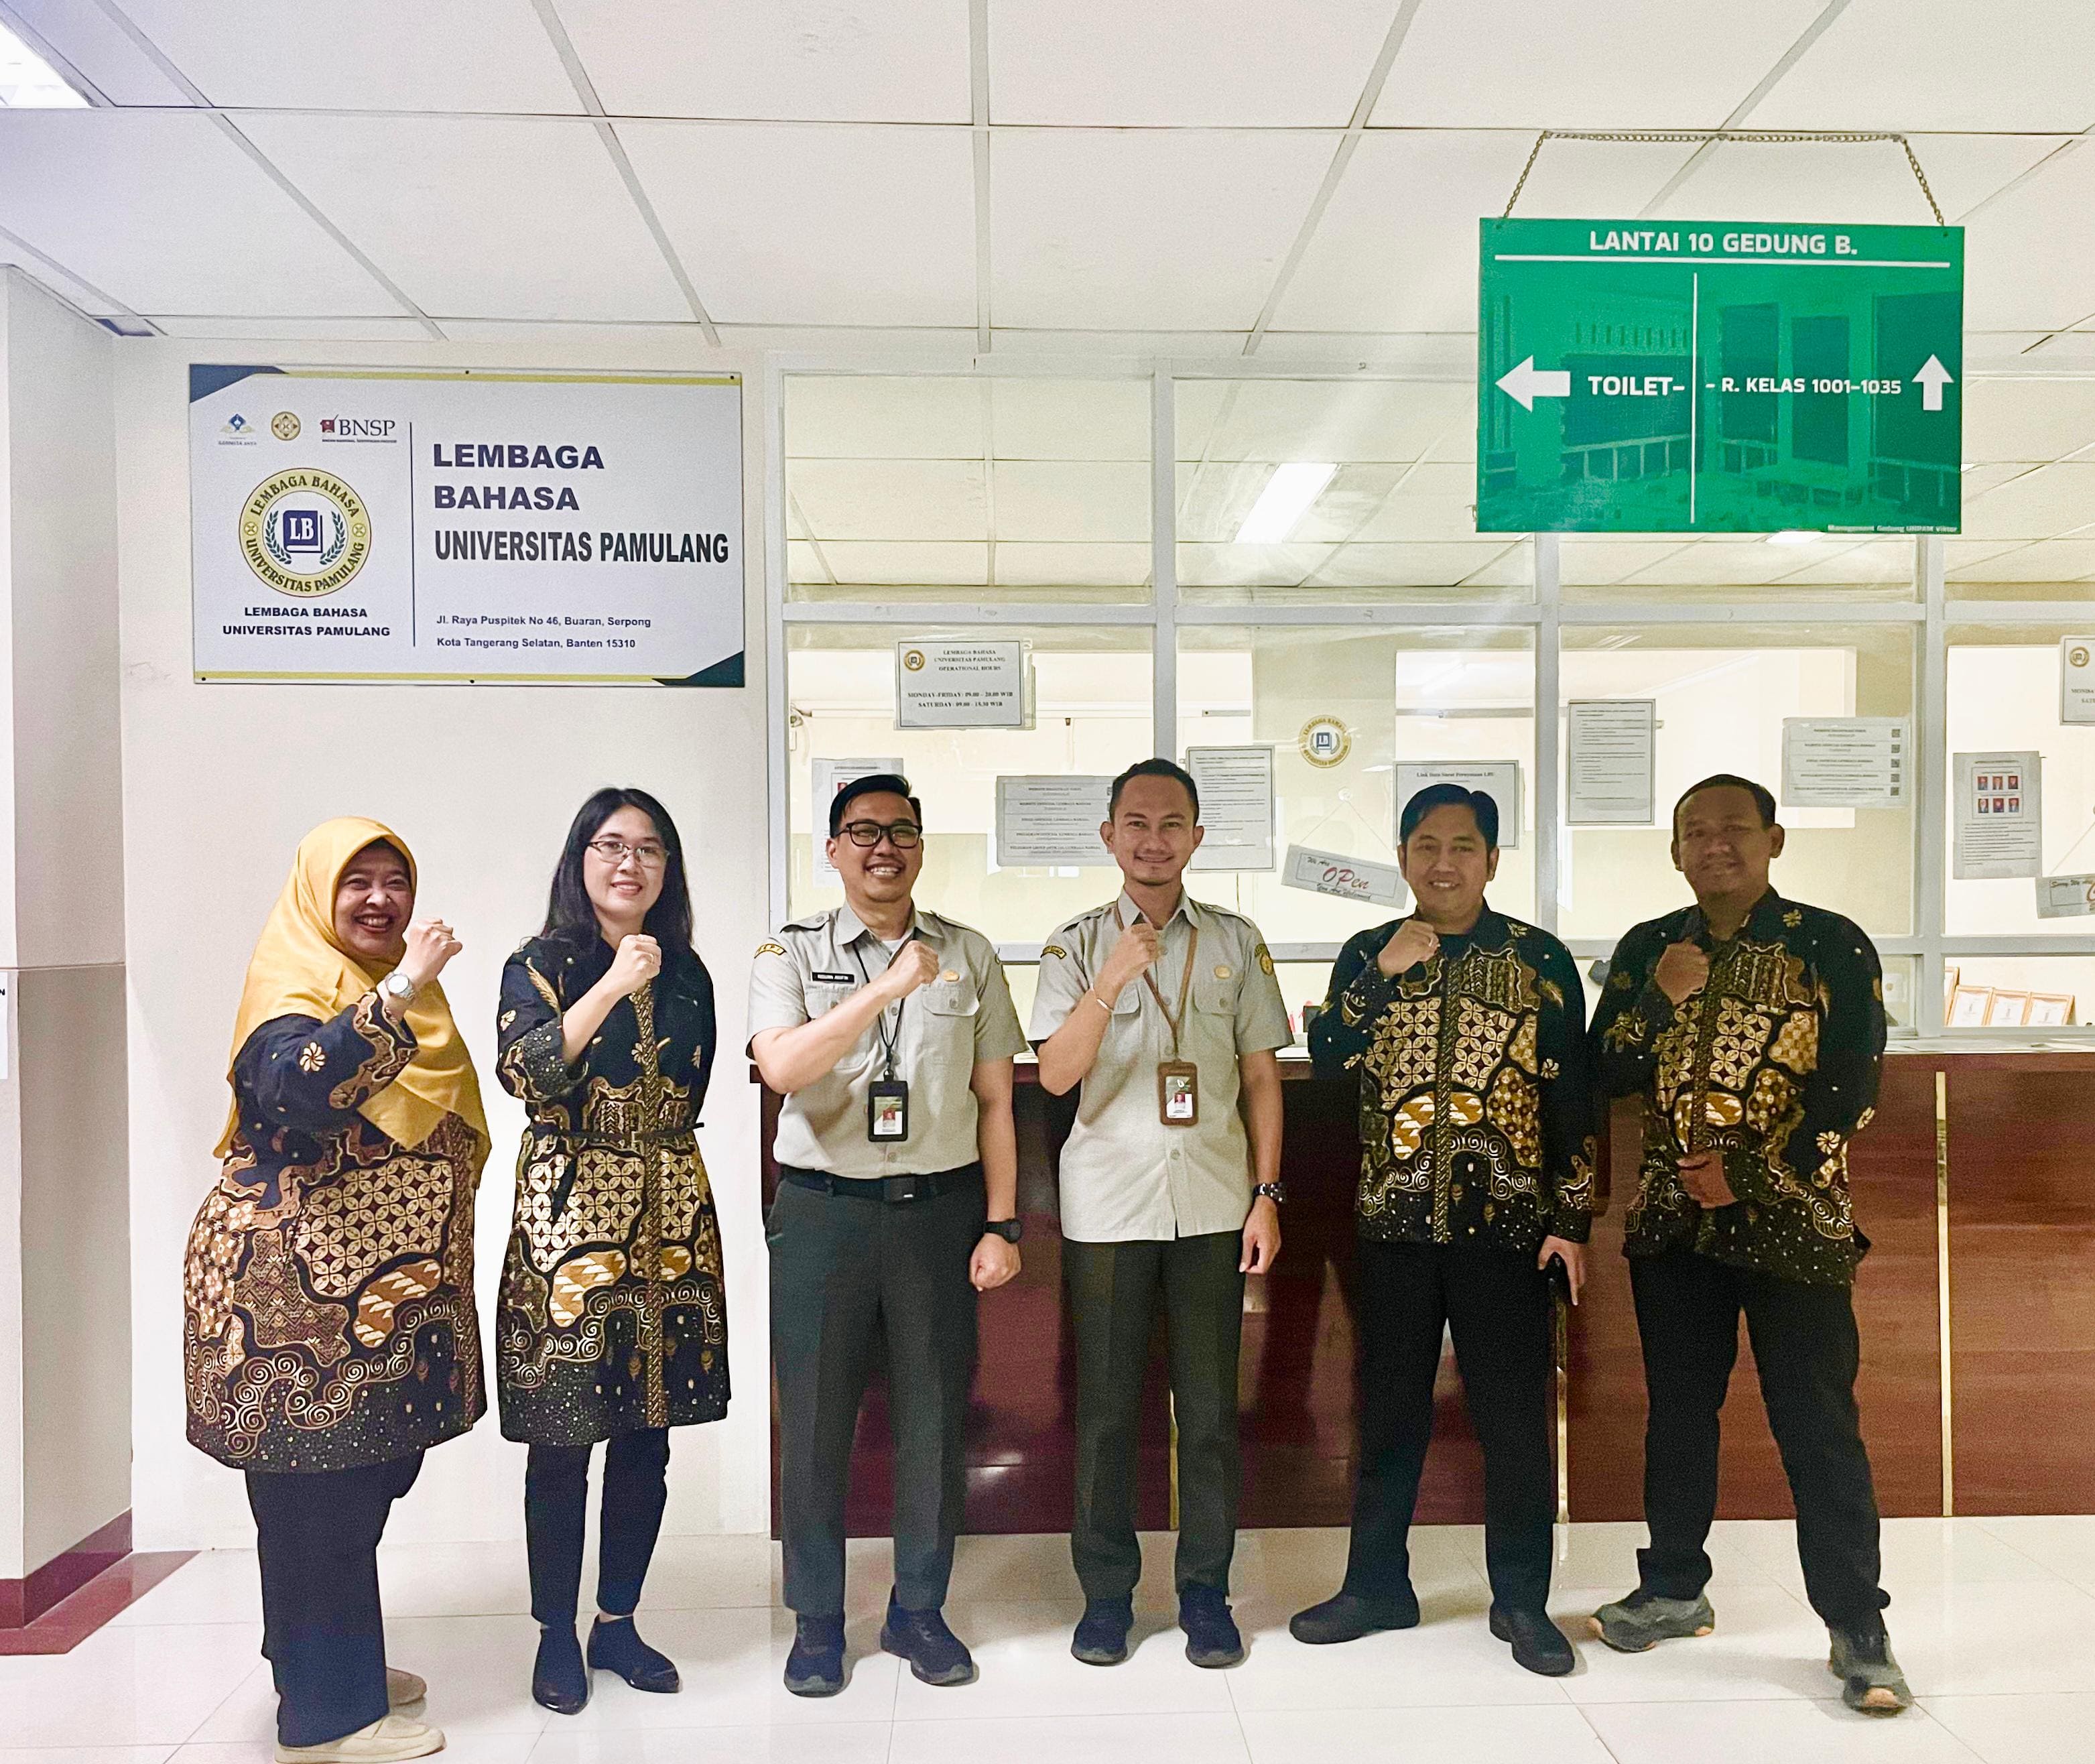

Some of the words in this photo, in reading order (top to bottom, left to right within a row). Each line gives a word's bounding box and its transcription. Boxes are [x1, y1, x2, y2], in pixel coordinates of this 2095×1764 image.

[1590, 231, 1679, 251] LANTAI
[1688, 233, 1714, 252] 10
[1722, 233, 1826, 254] GEDUNG
[1835, 235, 1857, 255] B.
[1722, 377, 1740, 392] R.
[1746, 377, 1805, 393] KELAS
[1812, 379, 1901, 394] 1001-1035
[339, 419, 395, 436] BNSP
[434, 444, 605, 469] LEMBAGA
[250, 475, 307, 517] LEMBAGA
[312, 476, 359, 517] BAHASA
[434, 485, 580, 511] BAHASA
[290, 517, 314, 540] LB
[434, 530, 592, 561] UNIVERSITAS
[600, 532, 728, 563] PAMULANG
[246, 538, 312, 592] UNIVERSITAS
[314, 542, 365, 591] PAMULANG
[245, 607, 309, 617] LEMBAGA
[313, 608, 367, 617] BAHASA
[452, 616, 478, 627] Raya
[481, 616, 526, 627] Puspitek
[529, 617, 544, 625] No
[546, 617, 561, 626] 46,
[565, 617, 605, 627] Buaran,
[607, 617, 651, 627] Serpong
[223, 625, 312, 635] UNIVERSITAS
[316, 626, 390, 636] PAMULANG
[437, 638, 461, 647] Kota
[464, 638, 519, 649] Tangerang
[522, 638, 564, 648] Selatan,
[566, 639, 602, 647] Banten
[607, 639, 635, 648] 15310
